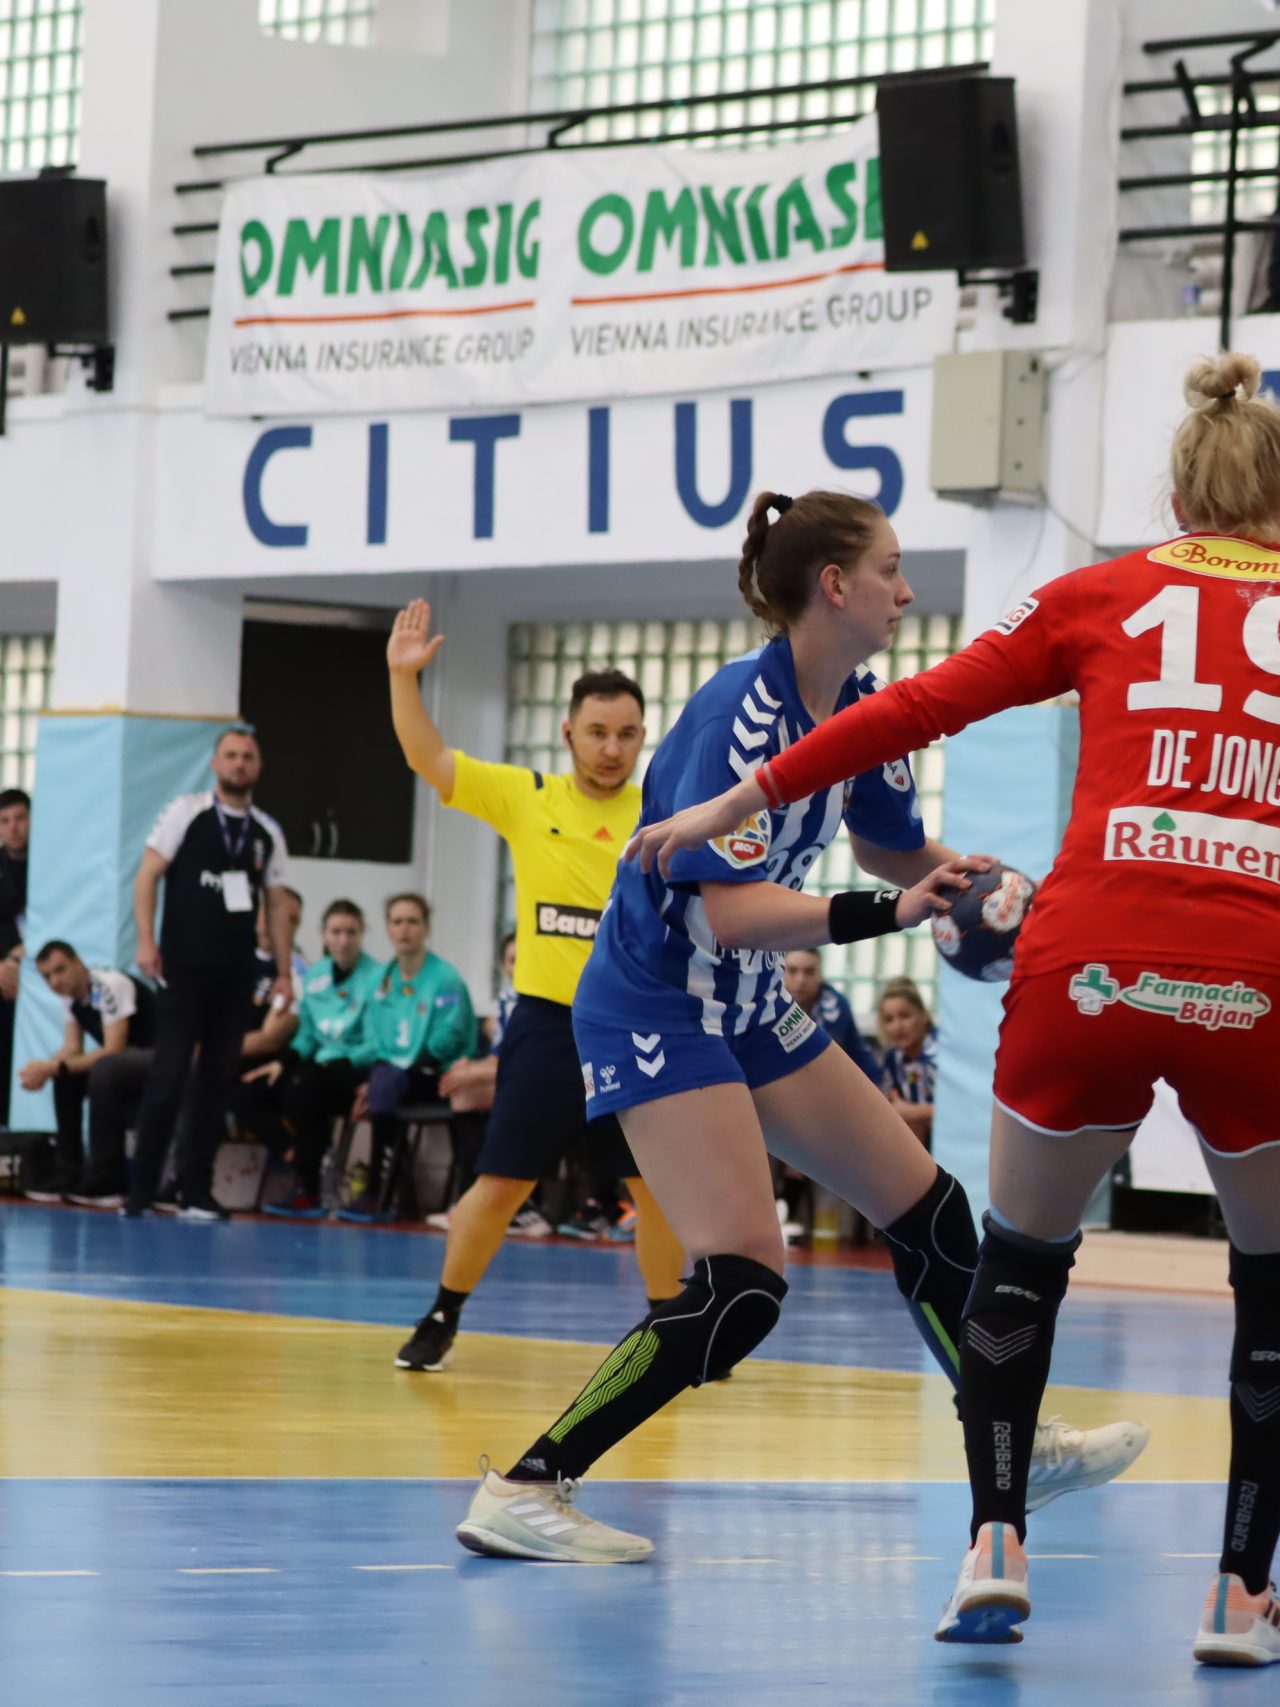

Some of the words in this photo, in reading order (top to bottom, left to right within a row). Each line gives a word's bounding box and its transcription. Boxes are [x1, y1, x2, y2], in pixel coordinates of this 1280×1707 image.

[239, 198, 541, 296] OMNIASIG
[570, 320, 668, 357] VIENNA
[676, 300, 818, 349] INSURANCE
[827, 287, 933, 328] GROUP
[229, 344, 307, 375] VIENNA
[316, 334, 450, 372] INSURANCE
[454, 327, 535, 365] GROUP
[242, 389, 905, 547] CITIUS
[1147, 729, 1197, 789] DE
[539, 906, 600, 937] Bau
[1139, 974, 1255, 1004] Farmacia
[1180, 1001, 1253, 1027] Băjan
